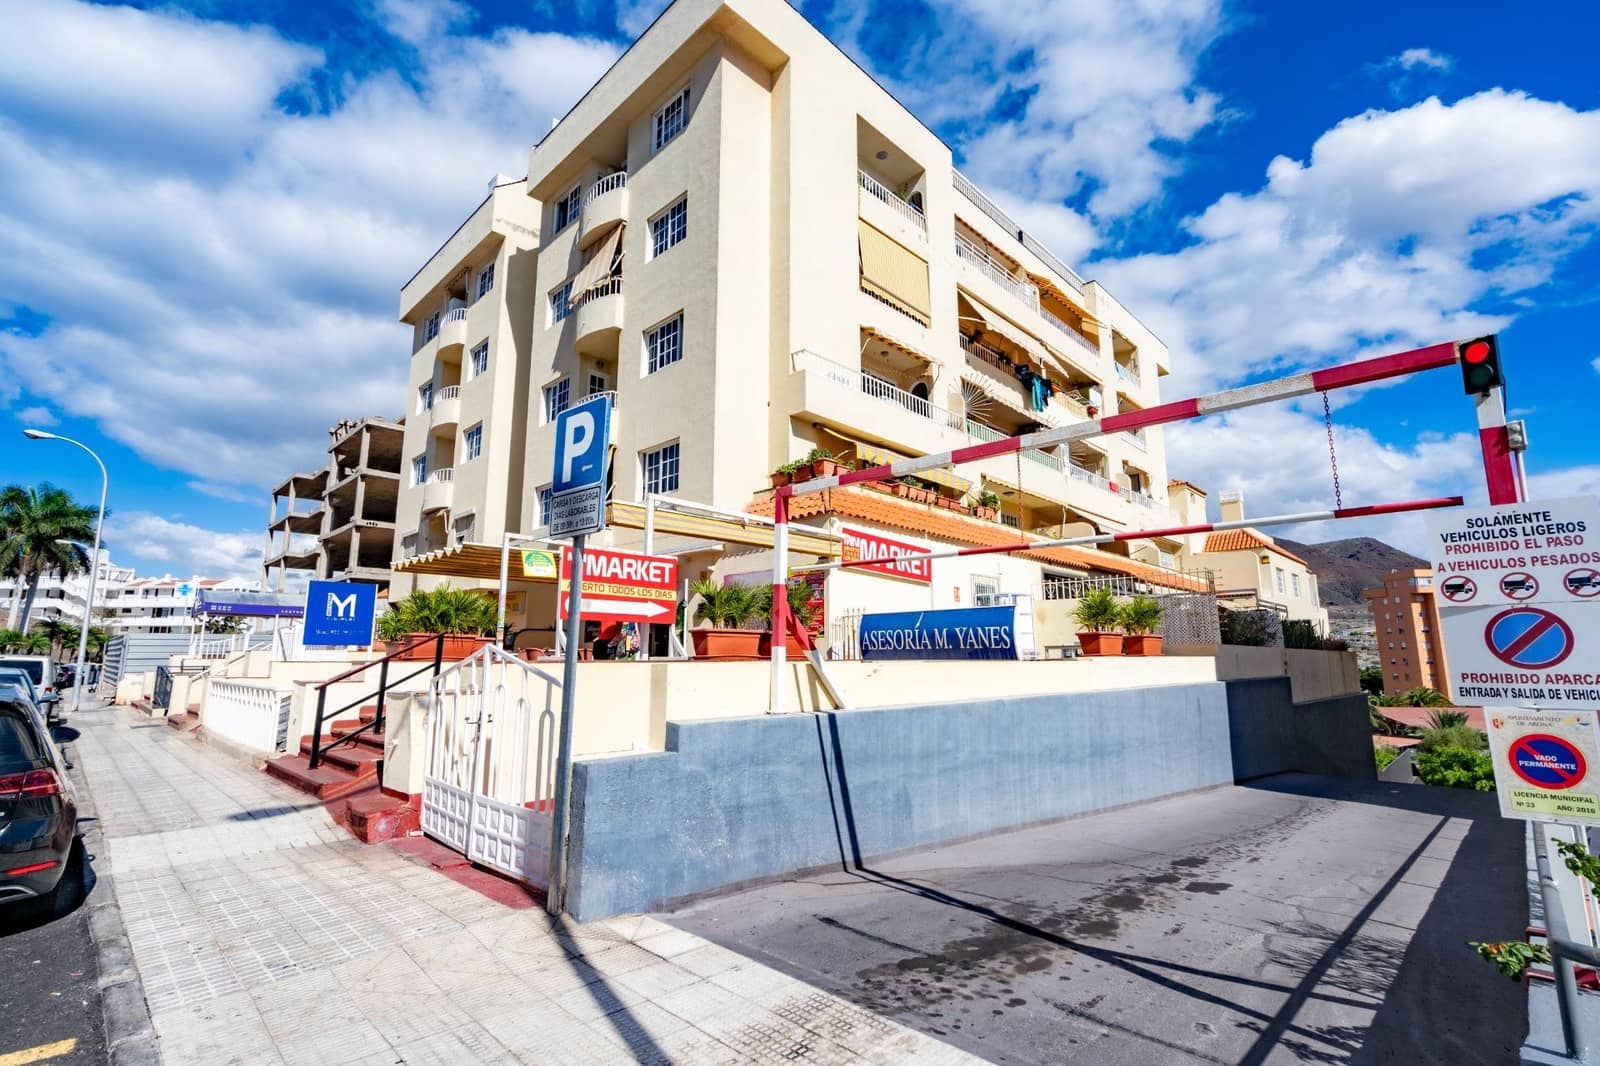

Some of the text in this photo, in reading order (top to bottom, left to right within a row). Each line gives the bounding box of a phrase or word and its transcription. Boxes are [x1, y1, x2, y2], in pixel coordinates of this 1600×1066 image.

[562, 411, 594, 483] P
[572, 490, 599, 504] DESCARGA
[1466, 511, 1552, 529] SOLAMENTE
[1440, 521, 1587, 543] VEHICULOS LIGEROS
[1445, 535, 1584, 555] PROHIBIDO EL PASO
[586, 554, 674, 584] MARKET
[1437, 551, 1600, 573] A VEHICULOS PESADOS
[608, 585, 635, 595] TODOS
[637, 588, 653, 597] LOS
[654, 590, 673, 599] DIAS
[862, 612, 1010, 650] ASESORÍA M. YANES
[1461, 672, 1540, 684] PROHIBIDO
[1459, 687, 1502, 698] ENTRADA
[1501, 688, 1508, 698] Y
[1511, 688, 1545, 699] SALIDA
[1548, 689, 1562, 699] DE
[1518, 759, 1576, 770] PERMANENTE
[1534, 754, 1557, 762] VADO
[1514, 791, 1595, 804] LICENCIA MUNICIPAL
